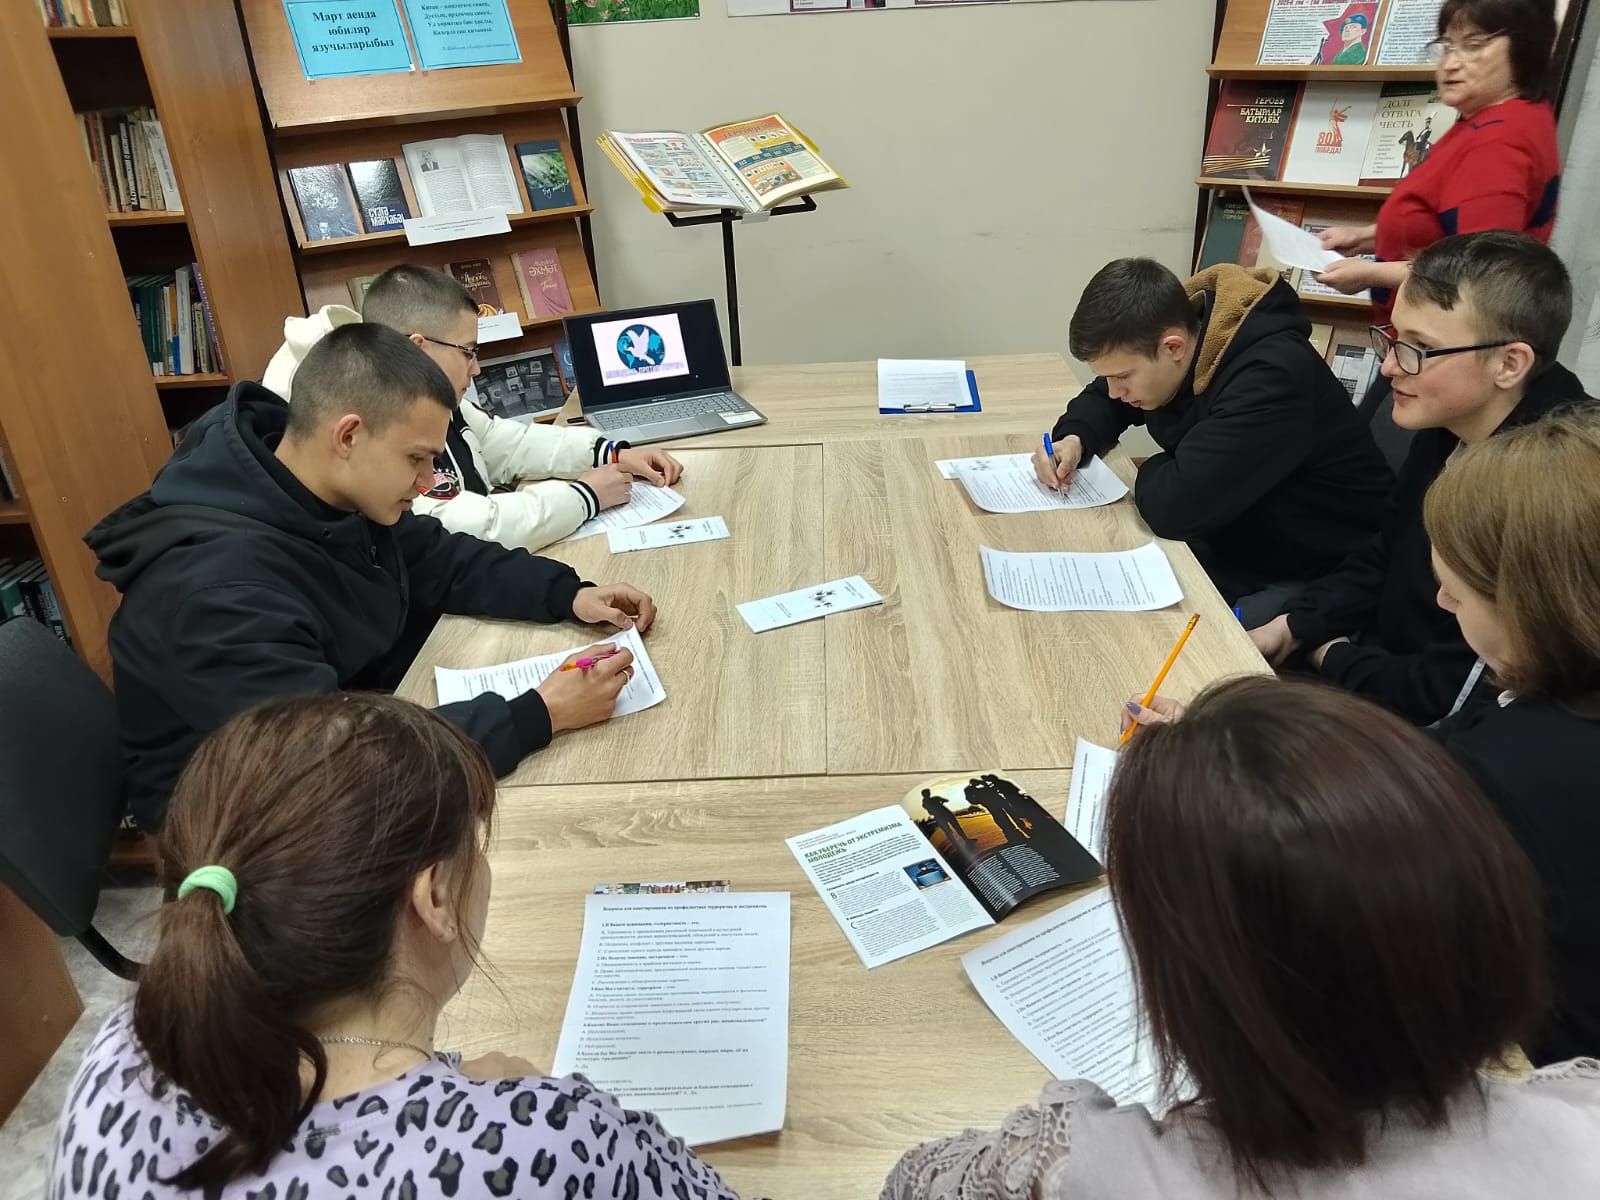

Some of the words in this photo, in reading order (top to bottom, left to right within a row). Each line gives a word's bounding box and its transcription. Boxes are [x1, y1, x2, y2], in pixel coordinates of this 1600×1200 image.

[312, 12, 342, 23] Март
[346, 10, 376, 20] аенда
[328, 26, 370, 36] юбиляр
[312, 38, 395, 54] язучыларыбыз
[1255, 96, 1284, 104] ГЕРОЕВ
[1383, 99, 1414, 109] ДОЛГ
[1381, 110, 1422, 118] ОТВАГА
[1246, 116, 1280, 124] КИТАБЫ
[804, 850, 818, 858] КАК
[818, 842, 848, 856] УБЕРЕЧЬ
[856, 822, 902, 842] ЭКСТРЕМИЗМА
